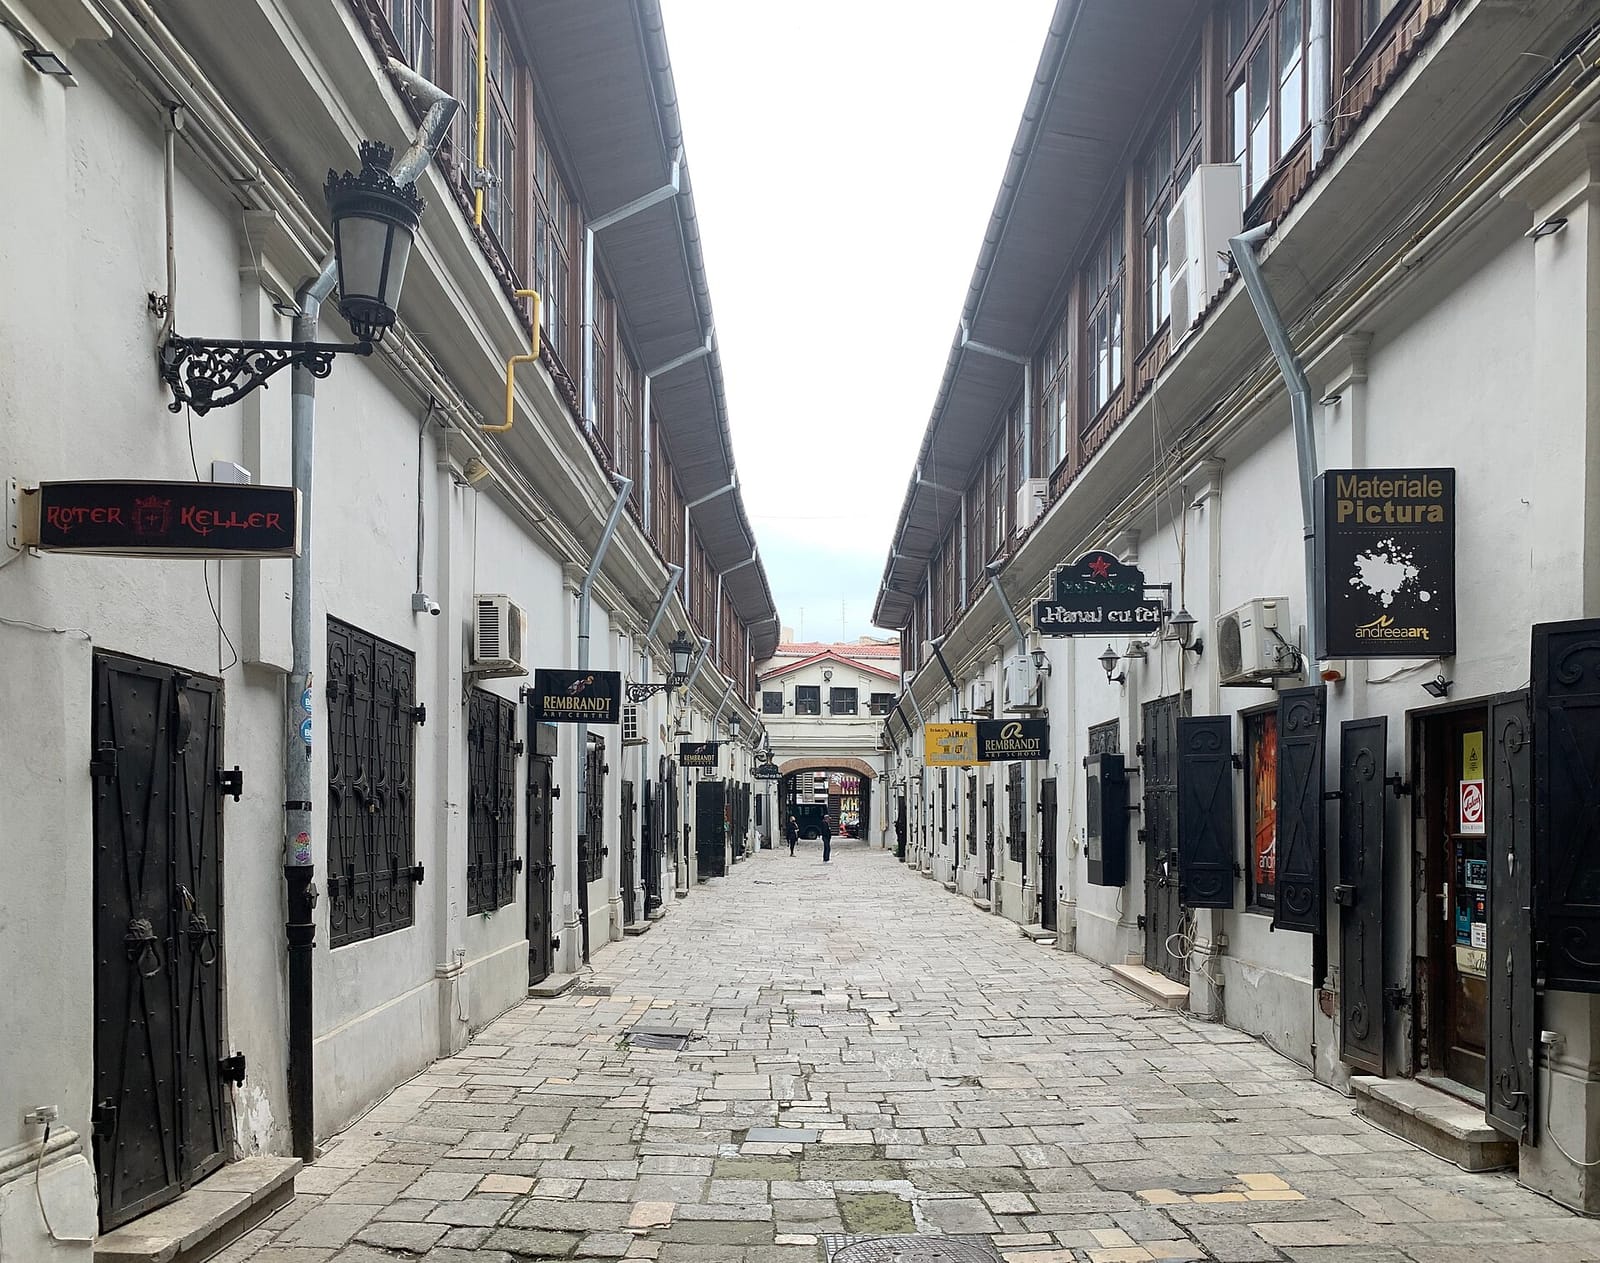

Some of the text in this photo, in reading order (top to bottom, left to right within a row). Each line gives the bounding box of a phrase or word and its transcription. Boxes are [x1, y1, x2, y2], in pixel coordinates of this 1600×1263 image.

[1336, 474, 1443, 499] Materiale
[1336, 500, 1444, 524] Pictura
[47, 505, 286, 537] ROTER KELLER
[1108, 609, 1133, 623] cu
[1355, 624, 1430, 640] andreeaart
[543, 695, 612, 711] REMBRANDT
[985, 738, 1040, 751] REMBRANDT
[683, 754, 715, 762] REMBRANDT
